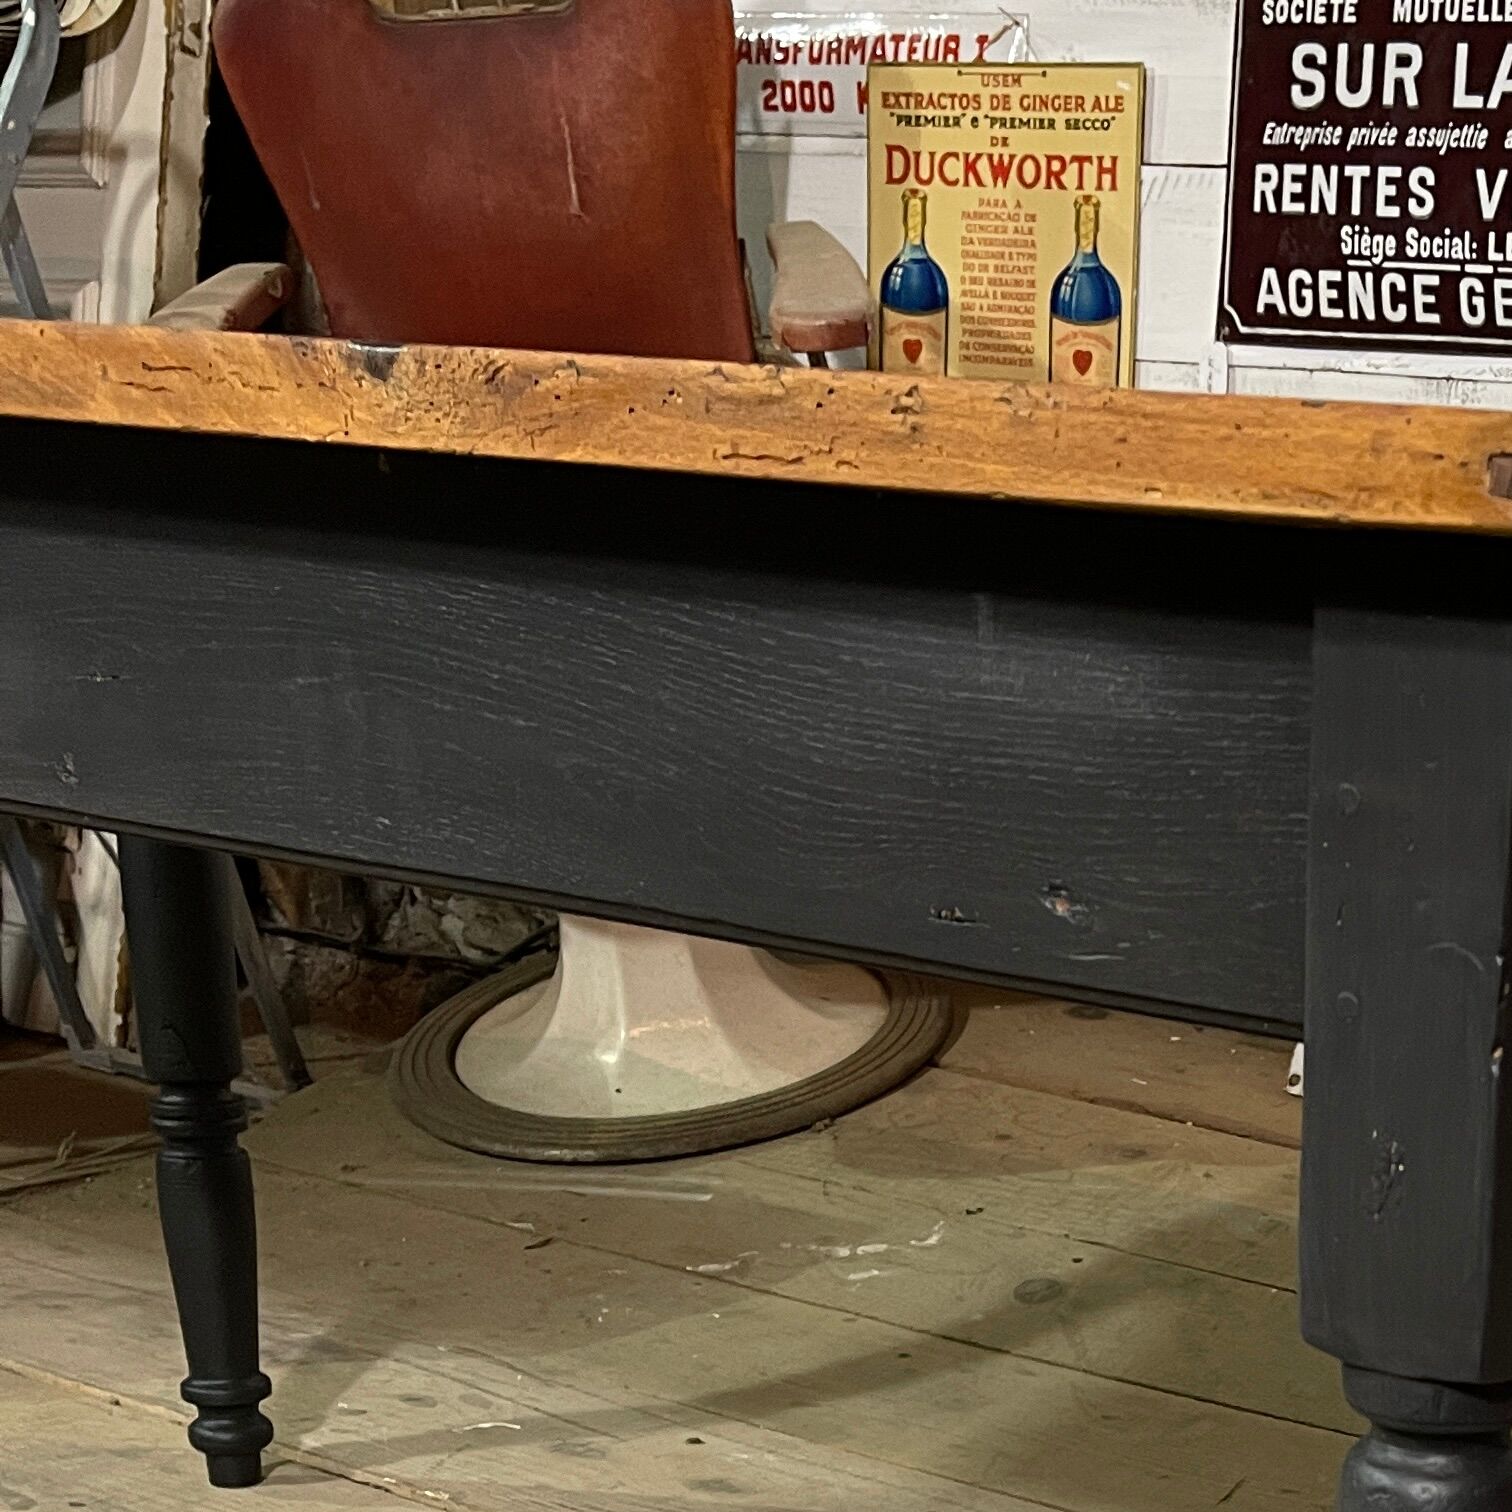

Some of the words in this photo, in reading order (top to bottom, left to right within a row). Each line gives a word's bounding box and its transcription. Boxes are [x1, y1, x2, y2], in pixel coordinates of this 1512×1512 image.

[736, 32, 960, 65] ANSFORMATEUR
[981, 74, 1022, 88] USEM
[1291, 42, 1423, 109] SUR
[761, 79, 836, 113] 2000
[881, 91, 981, 110] EXTRACTOS
[989, 94, 1011, 111] DE
[1019, 94, 1085, 112] GINGER
[1091, 95, 1124, 113] ALE
[990, 136, 1010, 147] DE
[1263, 121, 1343, 151] Entreprise
[1347, 121, 1398, 151] privée
[1405, 121, 1488, 155] assujettie
[885, 144, 1119, 192] DUCKWORTH
[1253, 163, 1435, 219] RENTES
[1341, 225, 1396, 265] Siège
[1406, 227, 1478, 259] Social:
[1257, 267, 1441, 324] AGENCE
